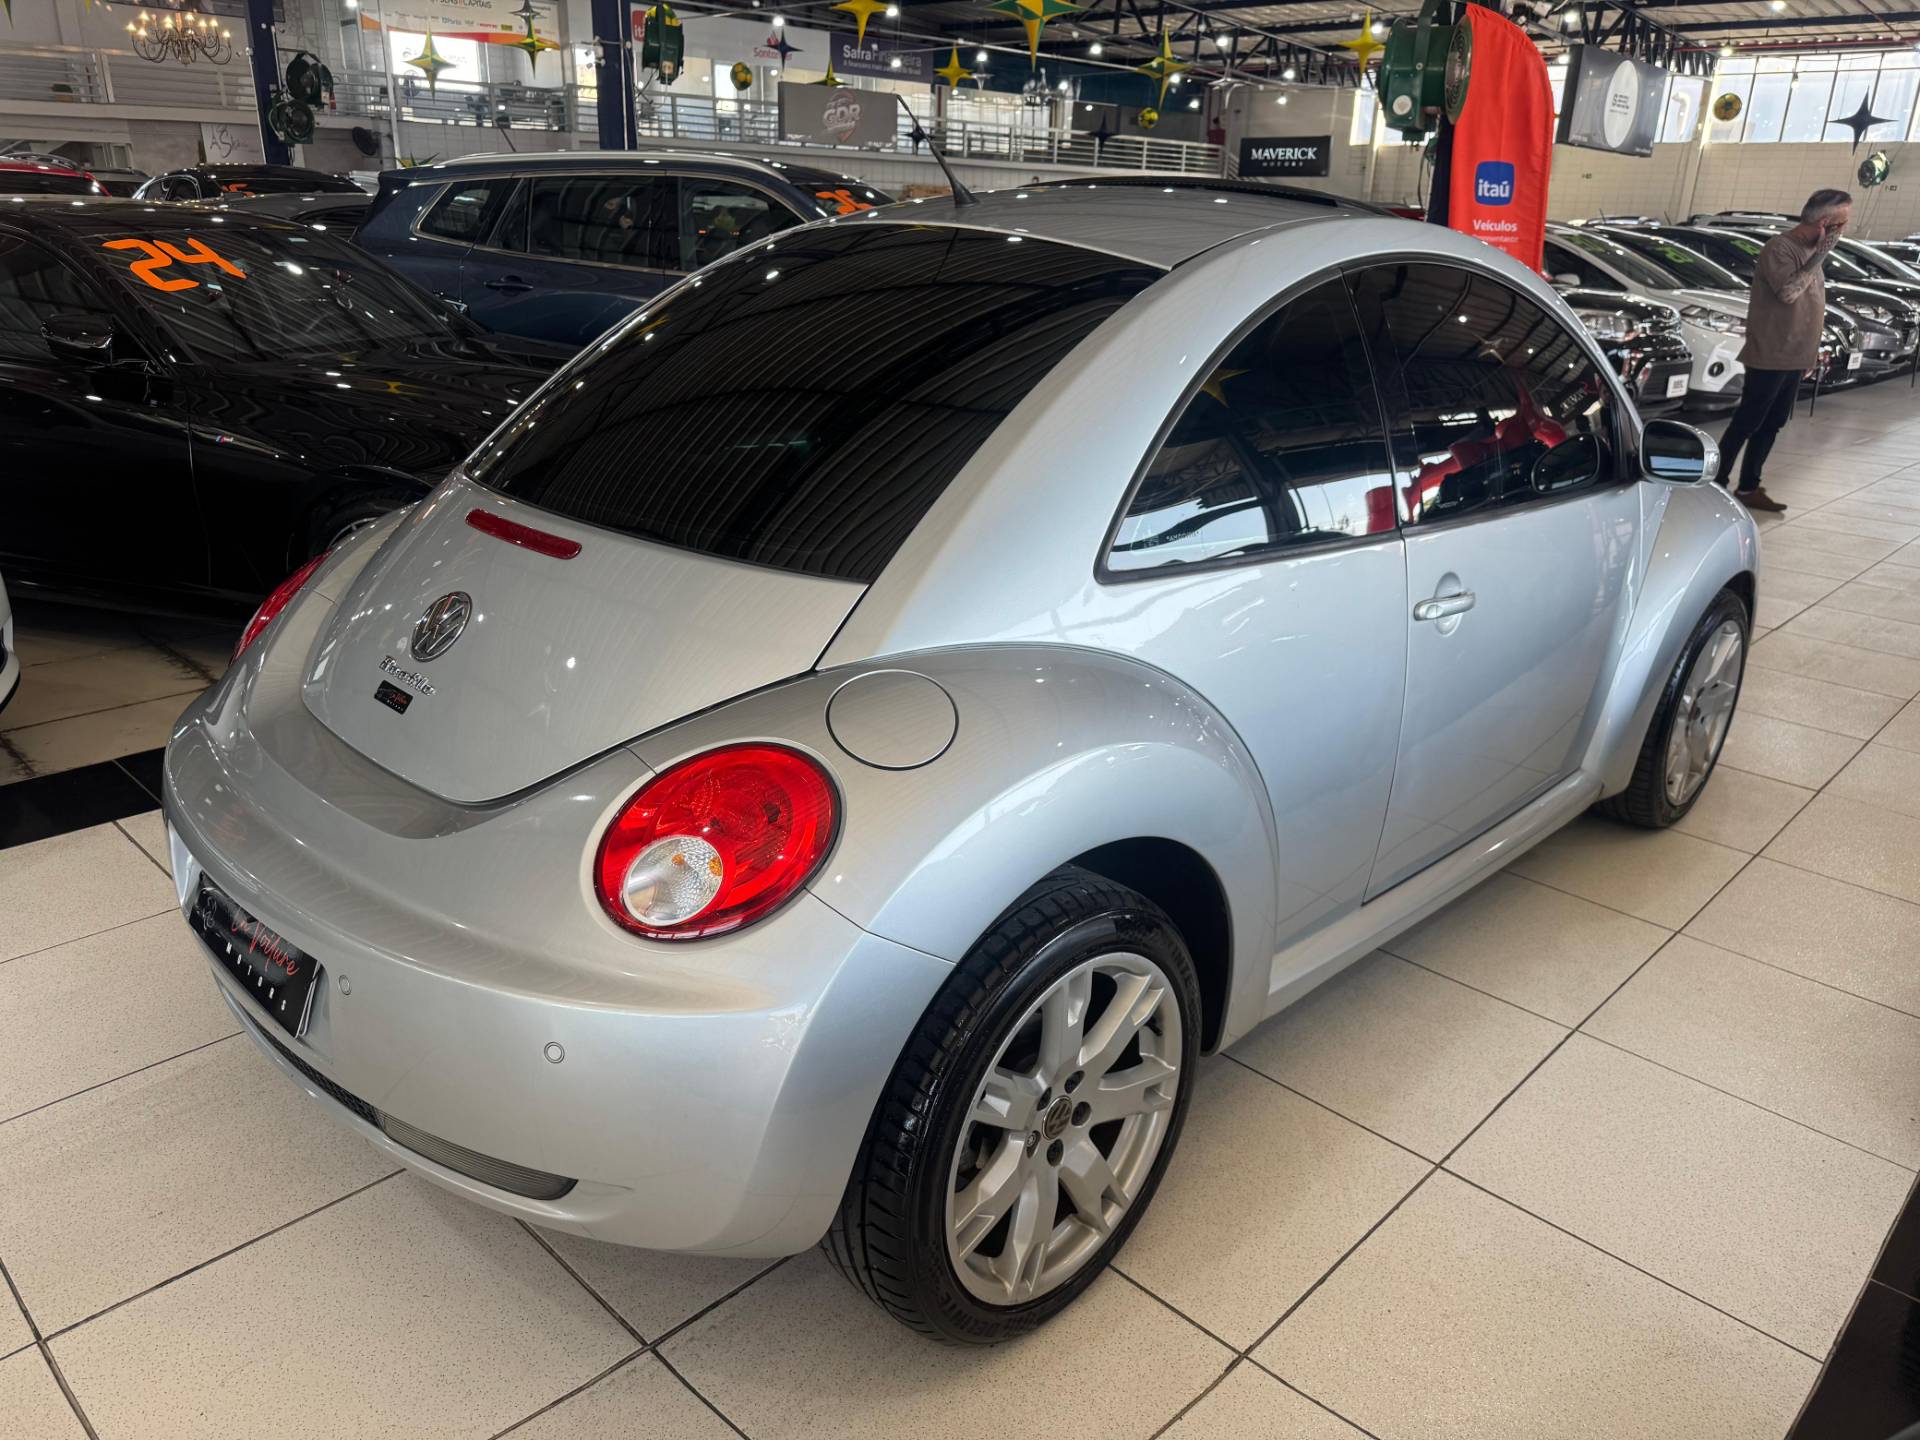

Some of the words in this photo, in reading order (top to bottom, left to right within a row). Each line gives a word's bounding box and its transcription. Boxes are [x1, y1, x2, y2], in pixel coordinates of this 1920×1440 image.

[1251, 147, 1318, 160] MAVERICK
[1477, 179, 1510, 198] itaú
[1473, 219, 1518, 232] Veículos
[101, 237, 247, 292] 24
